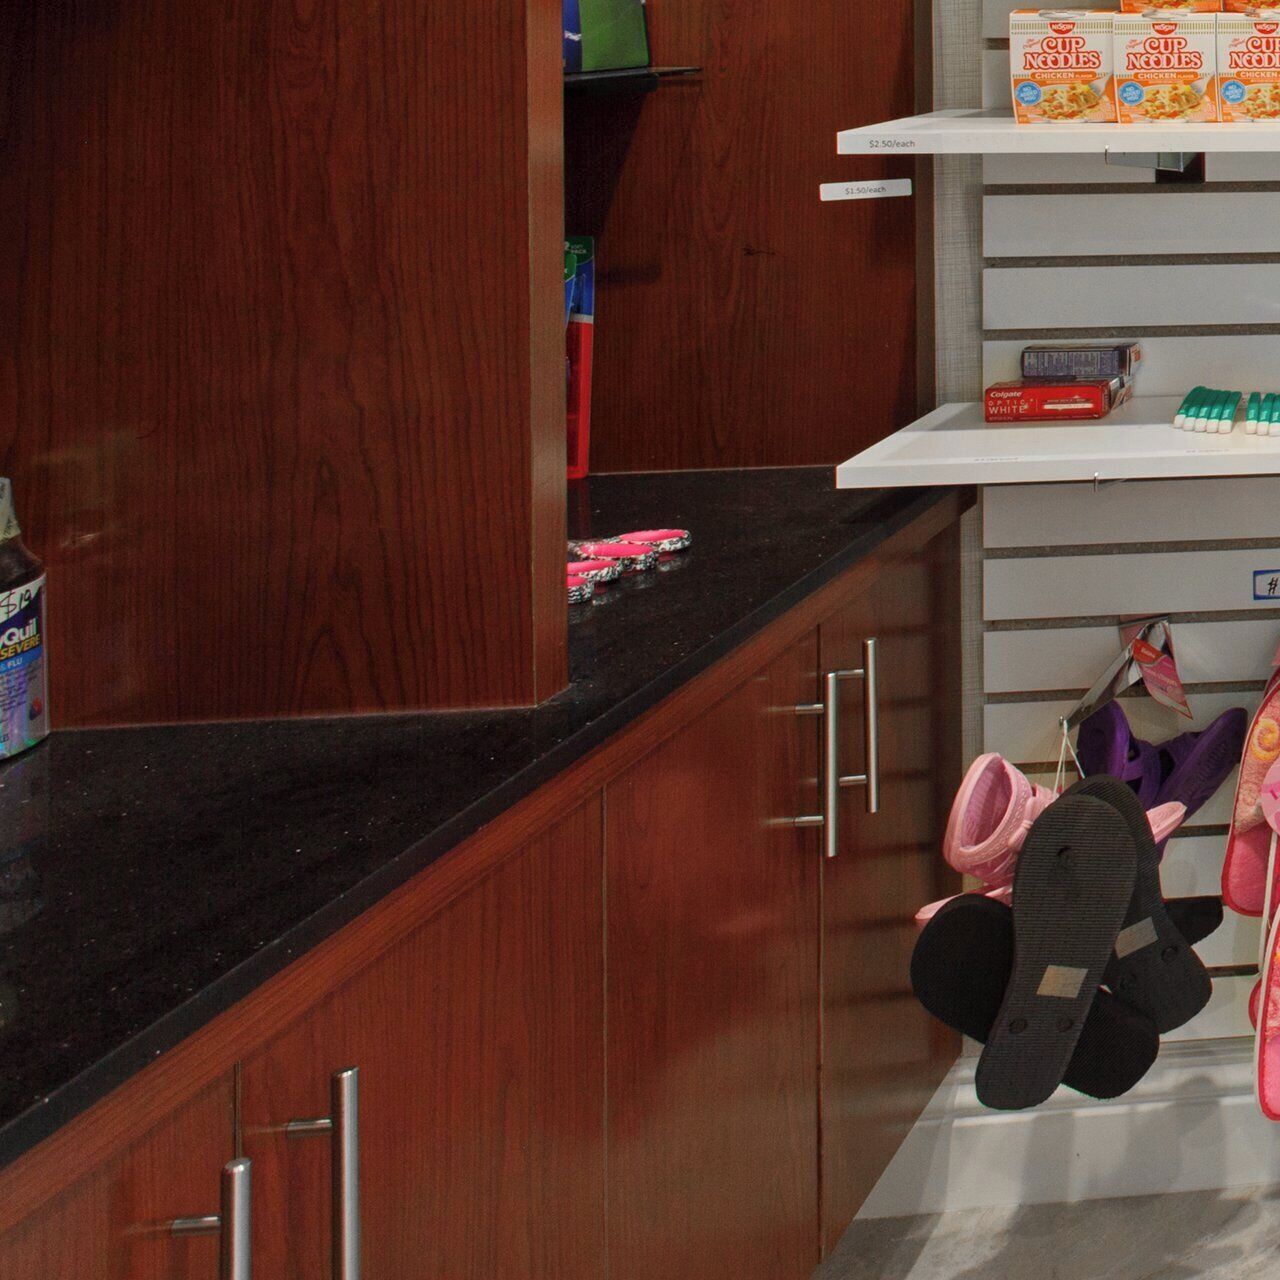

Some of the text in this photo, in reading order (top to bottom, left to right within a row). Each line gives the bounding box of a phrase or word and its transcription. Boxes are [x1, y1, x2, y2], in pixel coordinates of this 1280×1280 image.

[1041, 37, 1086, 53] CUP
[1024, 51, 1101, 70] NOODLES
[869, 139, 916, 149] $2.50/each
[845, 185, 887, 195] $1.50/each
[989, 390, 1022, 400] Colgate
[988, 405, 1026, 414] WHITE
[7, 657, 23, 668] FLU
